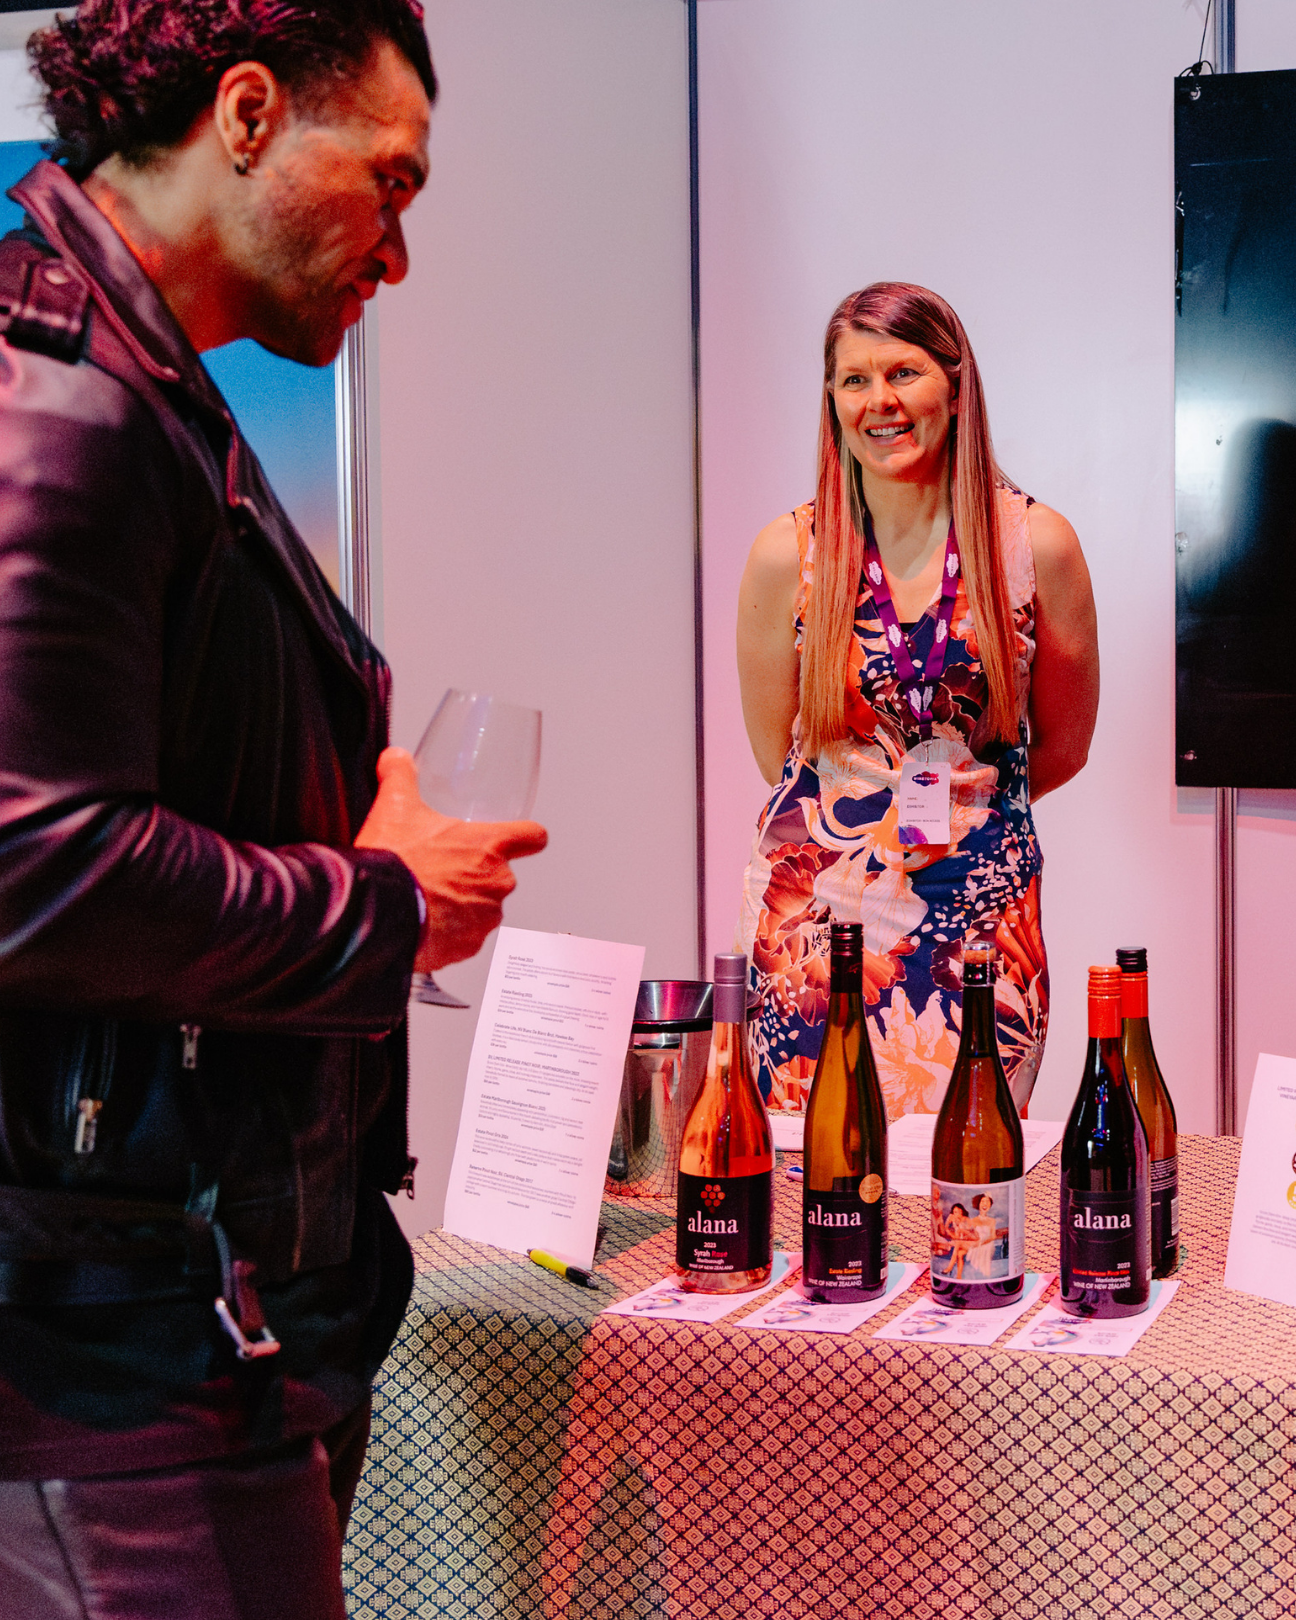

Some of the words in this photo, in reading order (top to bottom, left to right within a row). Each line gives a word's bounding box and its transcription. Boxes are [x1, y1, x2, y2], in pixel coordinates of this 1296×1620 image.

[688, 1211, 739, 1234] alana
[808, 1204, 862, 1227] alana
[1074, 1207, 1132, 1229] alana
[694, 1249, 710, 1258] Syrah
[1108, 1282, 1131, 1290] ZEALAND
